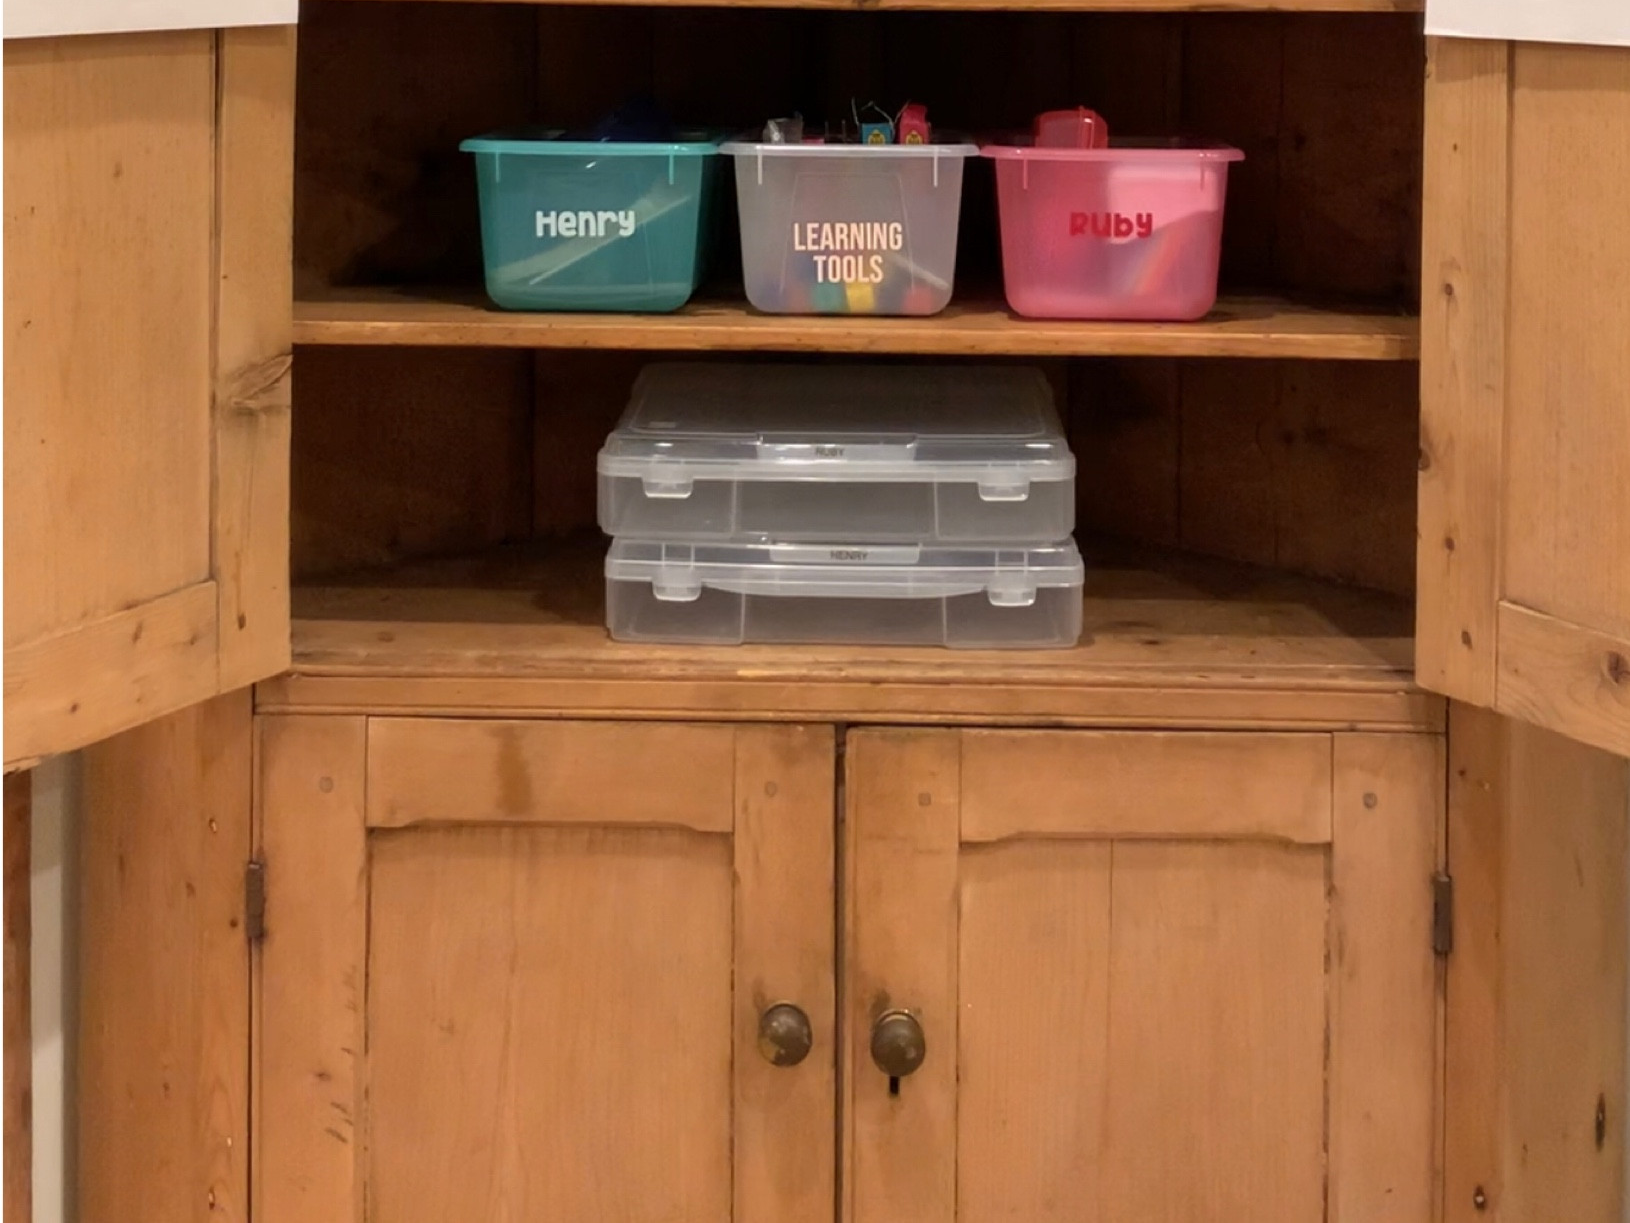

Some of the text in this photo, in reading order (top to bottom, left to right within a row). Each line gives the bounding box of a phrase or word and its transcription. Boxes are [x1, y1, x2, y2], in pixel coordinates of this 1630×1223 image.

[535, 209, 636, 237] Henry
[793, 221, 903, 252] LEARNING
[812, 254, 884, 284] TOOLS
[828, 549, 869, 563] HENRY
